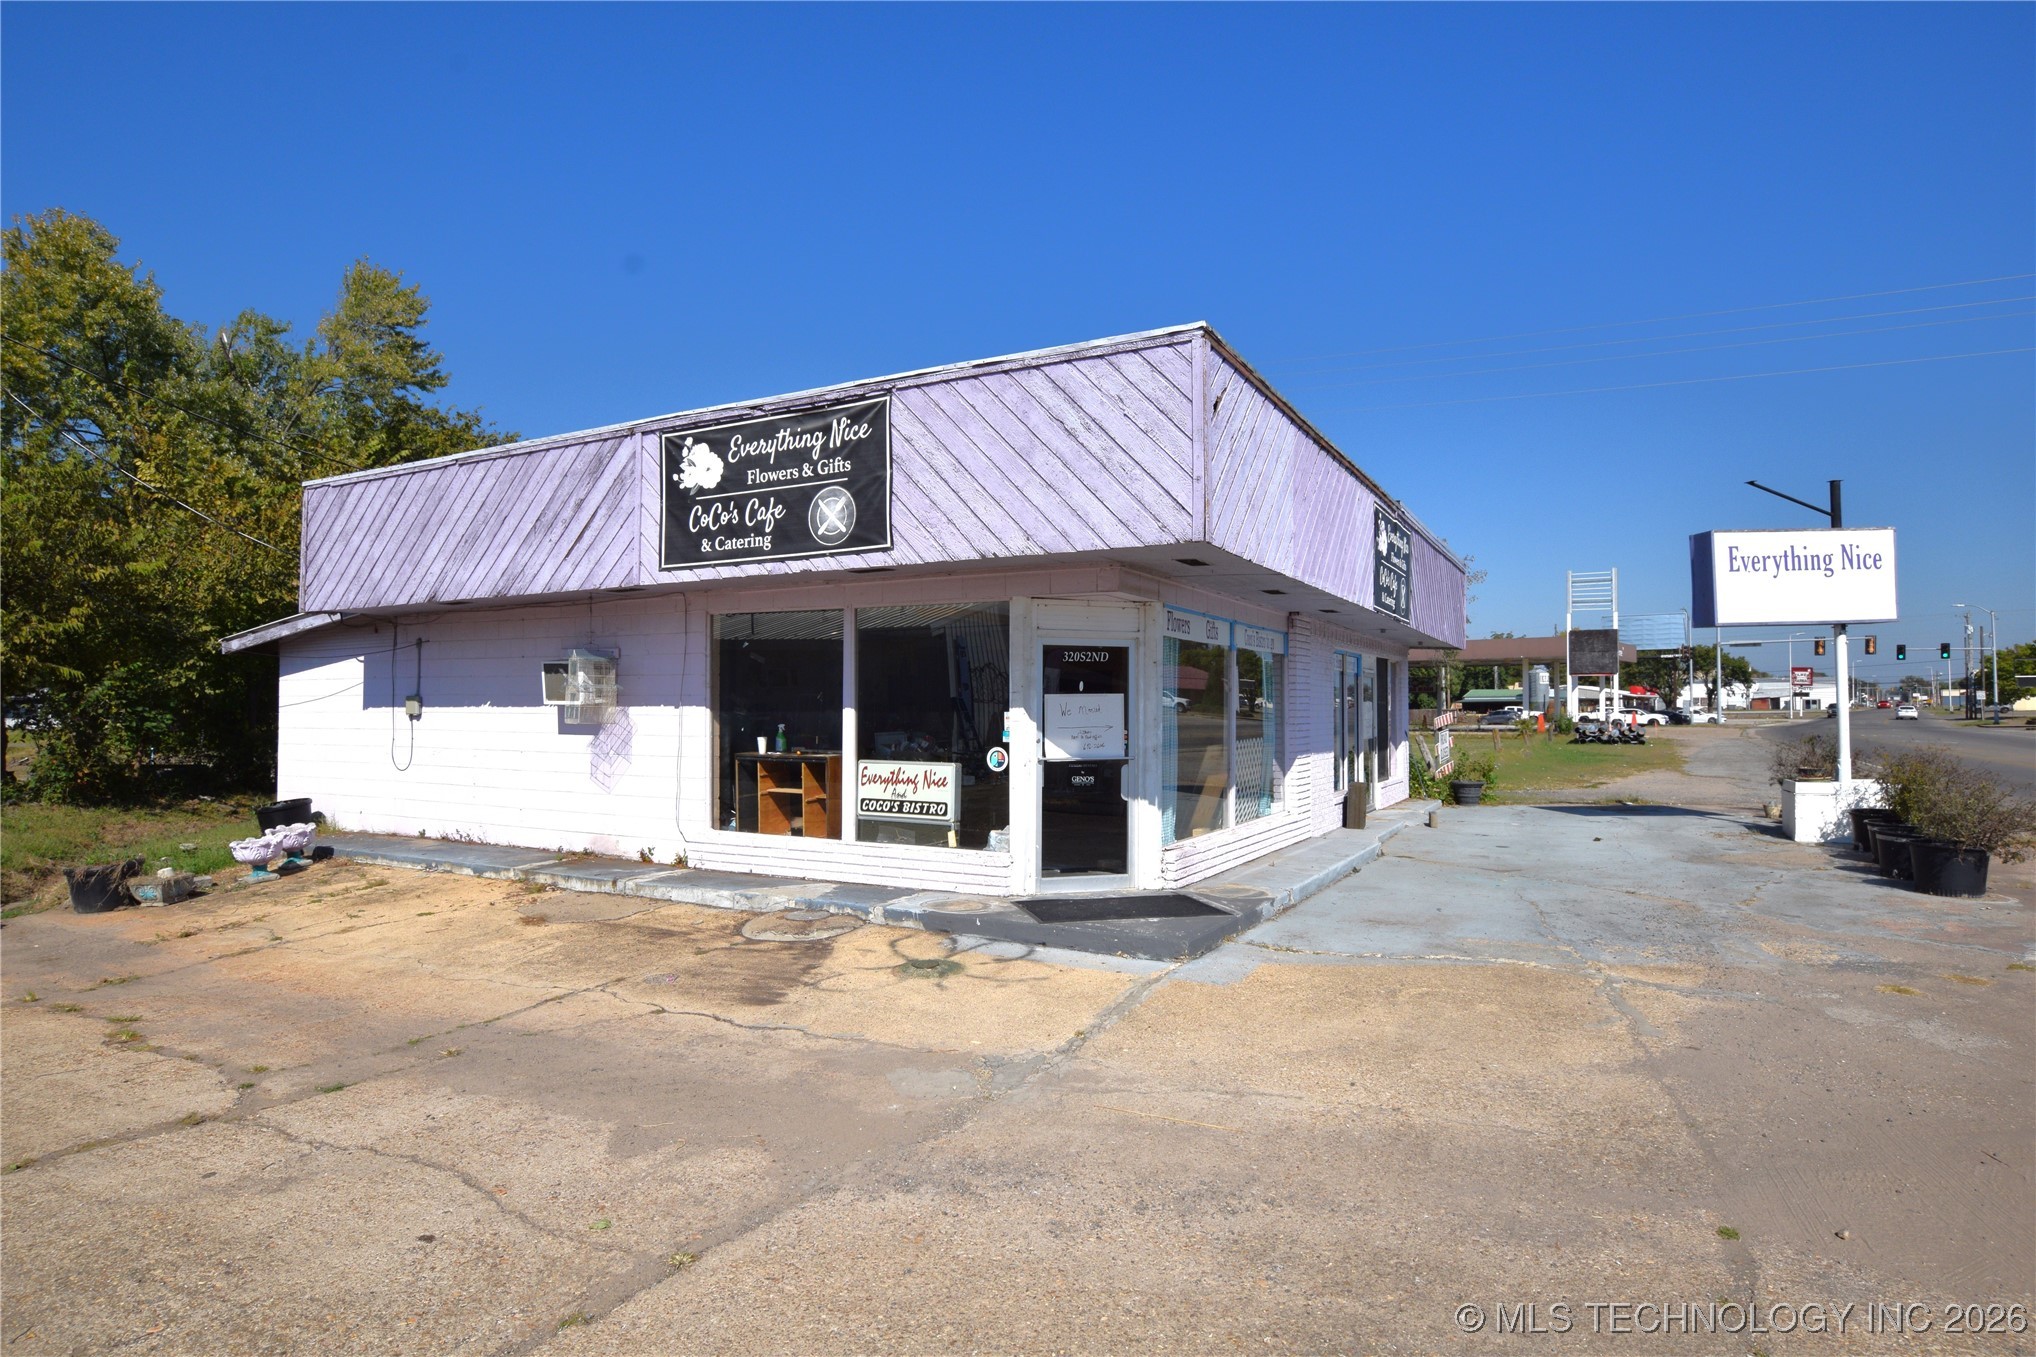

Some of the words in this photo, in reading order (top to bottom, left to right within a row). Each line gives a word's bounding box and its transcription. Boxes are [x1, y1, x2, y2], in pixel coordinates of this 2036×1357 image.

[727, 428, 827, 464] Everything
[829, 416, 872, 448] Nice
[747, 467, 799, 485] Flowers
[802, 463, 814, 477] &
[817, 457, 851, 475] Gifts
[689, 501, 739, 533] CoCo's
[745, 497, 786, 532] Cafe
[701, 539, 712, 552] &
[715, 534, 772, 551] Catering
[1728, 545, 1835, 578] Everything
[1840, 544, 1883, 571] Nice
[1167, 610, 1191, 635] Flowers
[1205, 620, 1219, 640] Gifts
[861, 766, 920, 795] Everything
[922, 769, 948, 790] Nice
[891, 788, 907, 799] And
[862, 799, 899, 812] COCO'S
[902, 802, 945, 815] BISTRO
